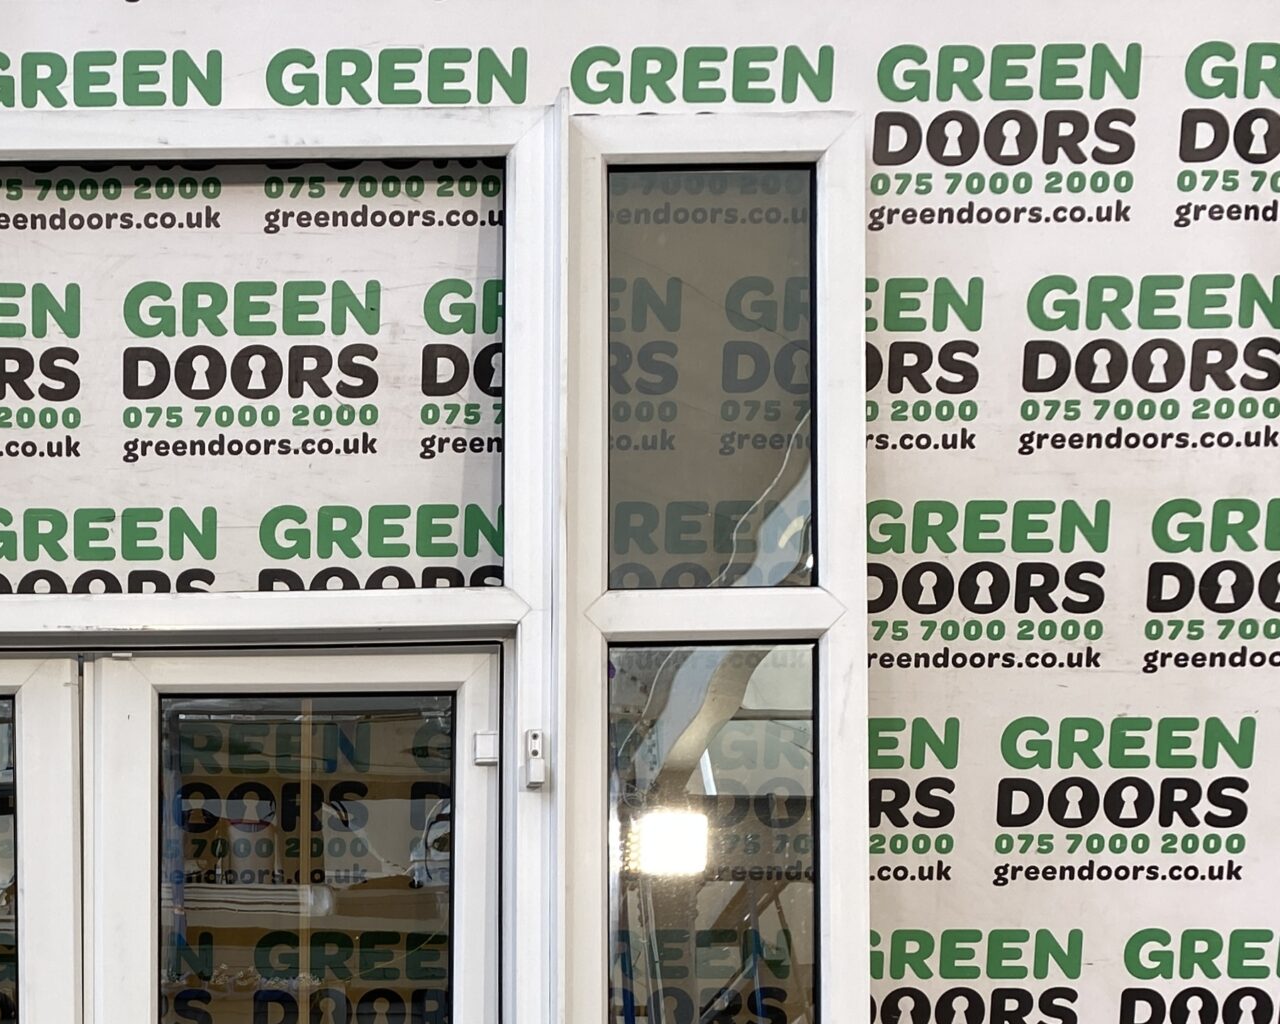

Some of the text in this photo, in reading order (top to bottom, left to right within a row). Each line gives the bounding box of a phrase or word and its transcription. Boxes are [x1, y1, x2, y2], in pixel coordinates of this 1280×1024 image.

[266, 47, 527, 106] GREEN
[570, 45, 834, 104] GREEN
[877, 43, 1142, 102] GREEN
[872, 108, 1136, 166] DOORS
[35, 177, 120, 202] 7000
[134, 177, 221, 202] 2000
[264, 176, 424, 200] 075 7000
[870, 171, 1133, 196] 075 7000 2000
[1177, 170, 1239, 192] 075
[867, 200, 1131, 231] greendoors.co.uk
[123, 280, 381, 338] GREEN
[1027, 273, 1280, 331] GREEN
[123, 344, 378, 400] DOORS
[1022, 337, 1280, 393] DOORS
[123, 402, 378, 428] 075 7000 2000
[421, 403, 482, 425] 075
[891, 400, 978, 422] 2000
[1021, 397, 1280, 421] 075 7000 2000
[123, 432, 377, 463] greendoors.co.uk
[1018, 425, 1278, 455] greendoors.co.uk
[259, 504, 504, 560] GREEN
[866, 499, 1110, 555] GREEN
[920, 619, 1103, 641] 7000 2000
[1145, 619, 1204, 640] 075
[1001, 717, 1256, 769] GREEN
[996, 777, 1249, 828] DOORS
[869, 834, 954, 854] 2000
[995, 833, 1245, 854] 075 7000 2000
[993, 860, 1242, 886] greendoors.co.uk
[254, 931, 448, 981] GREE
